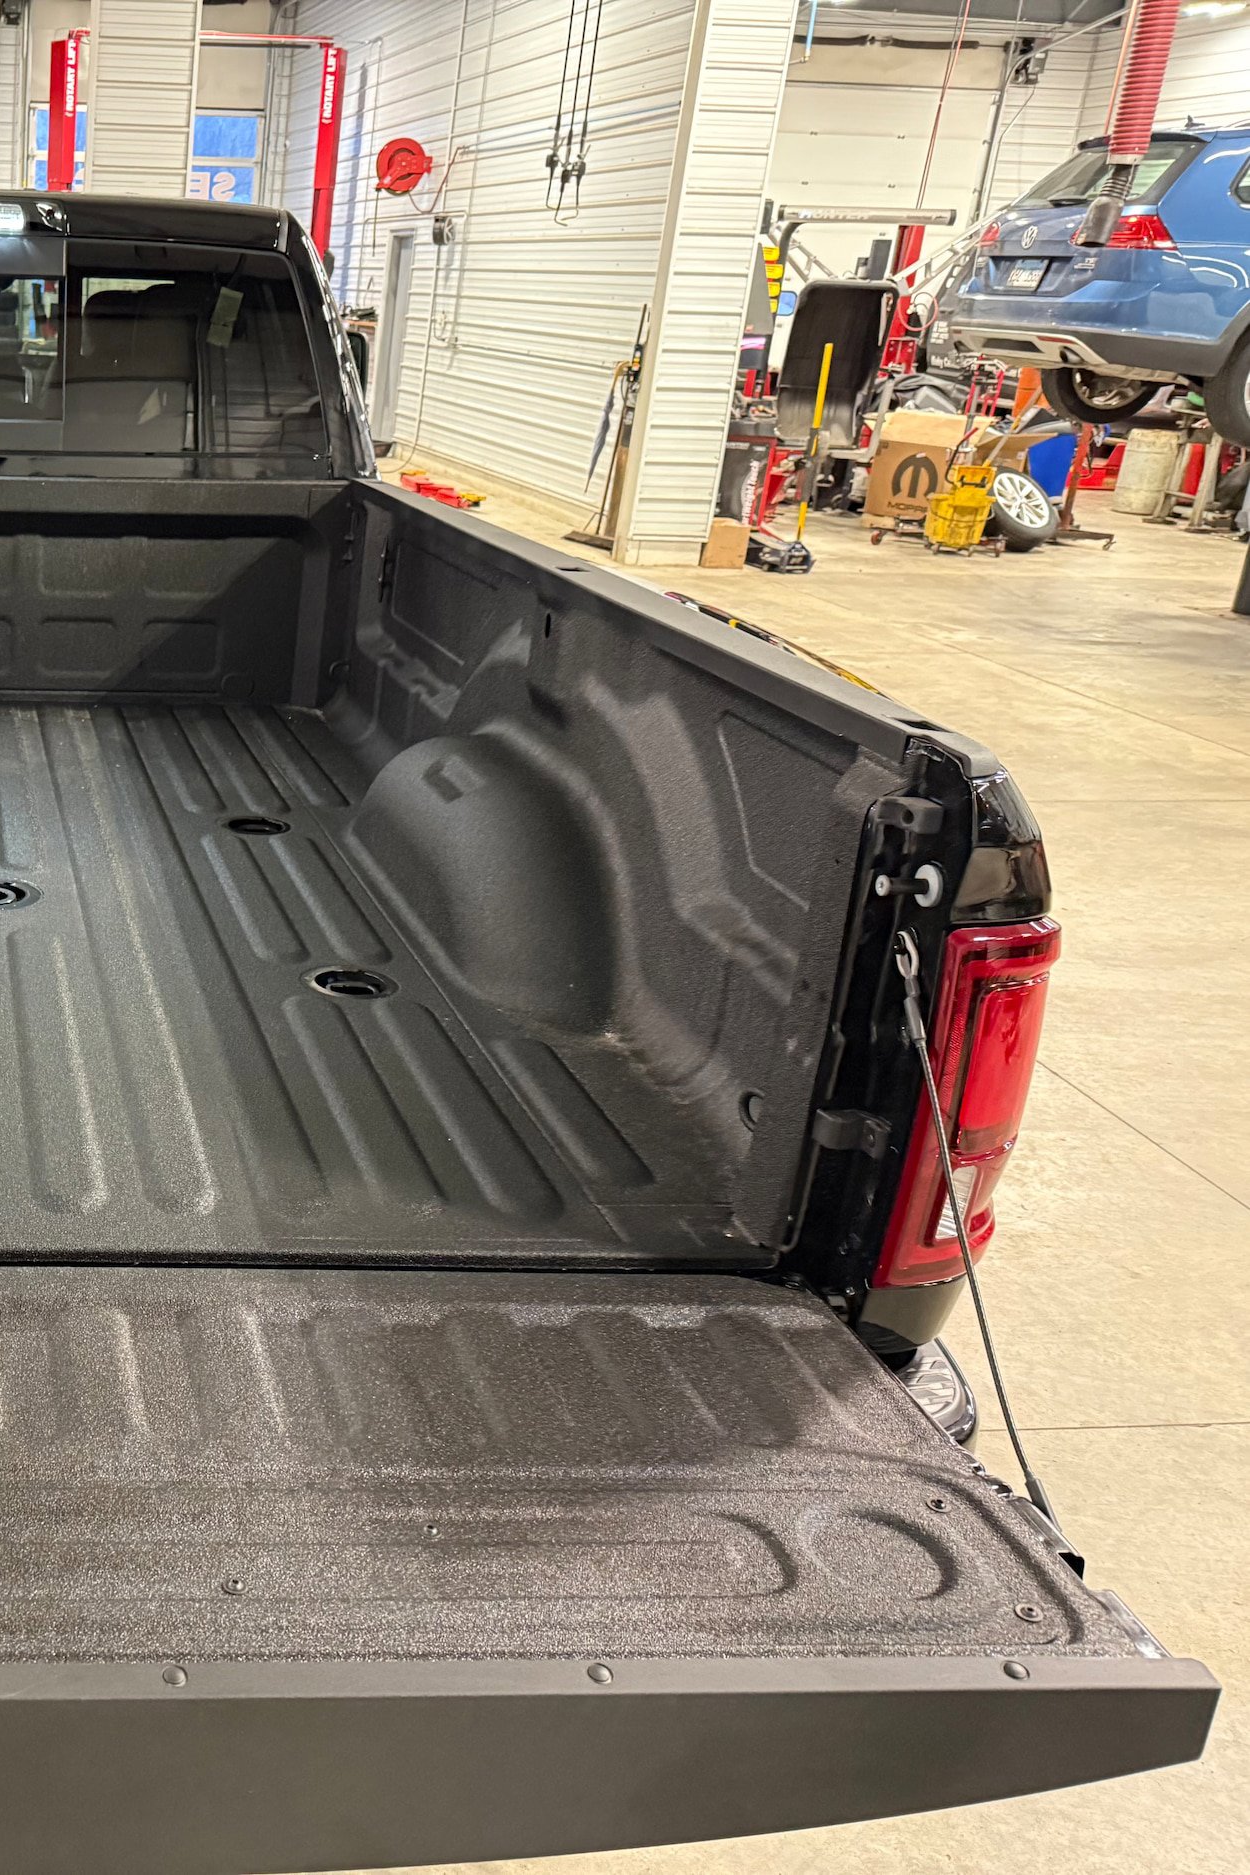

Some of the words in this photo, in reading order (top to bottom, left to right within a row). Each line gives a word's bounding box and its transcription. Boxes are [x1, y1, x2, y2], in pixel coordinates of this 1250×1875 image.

[67, 39, 77, 65] LIFT
[326, 48, 338, 72] LIFT
[65, 67, 76, 112] ROTARY
[322, 74, 336, 118] ROTARY
[798, 208, 870, 220] HUNTER
